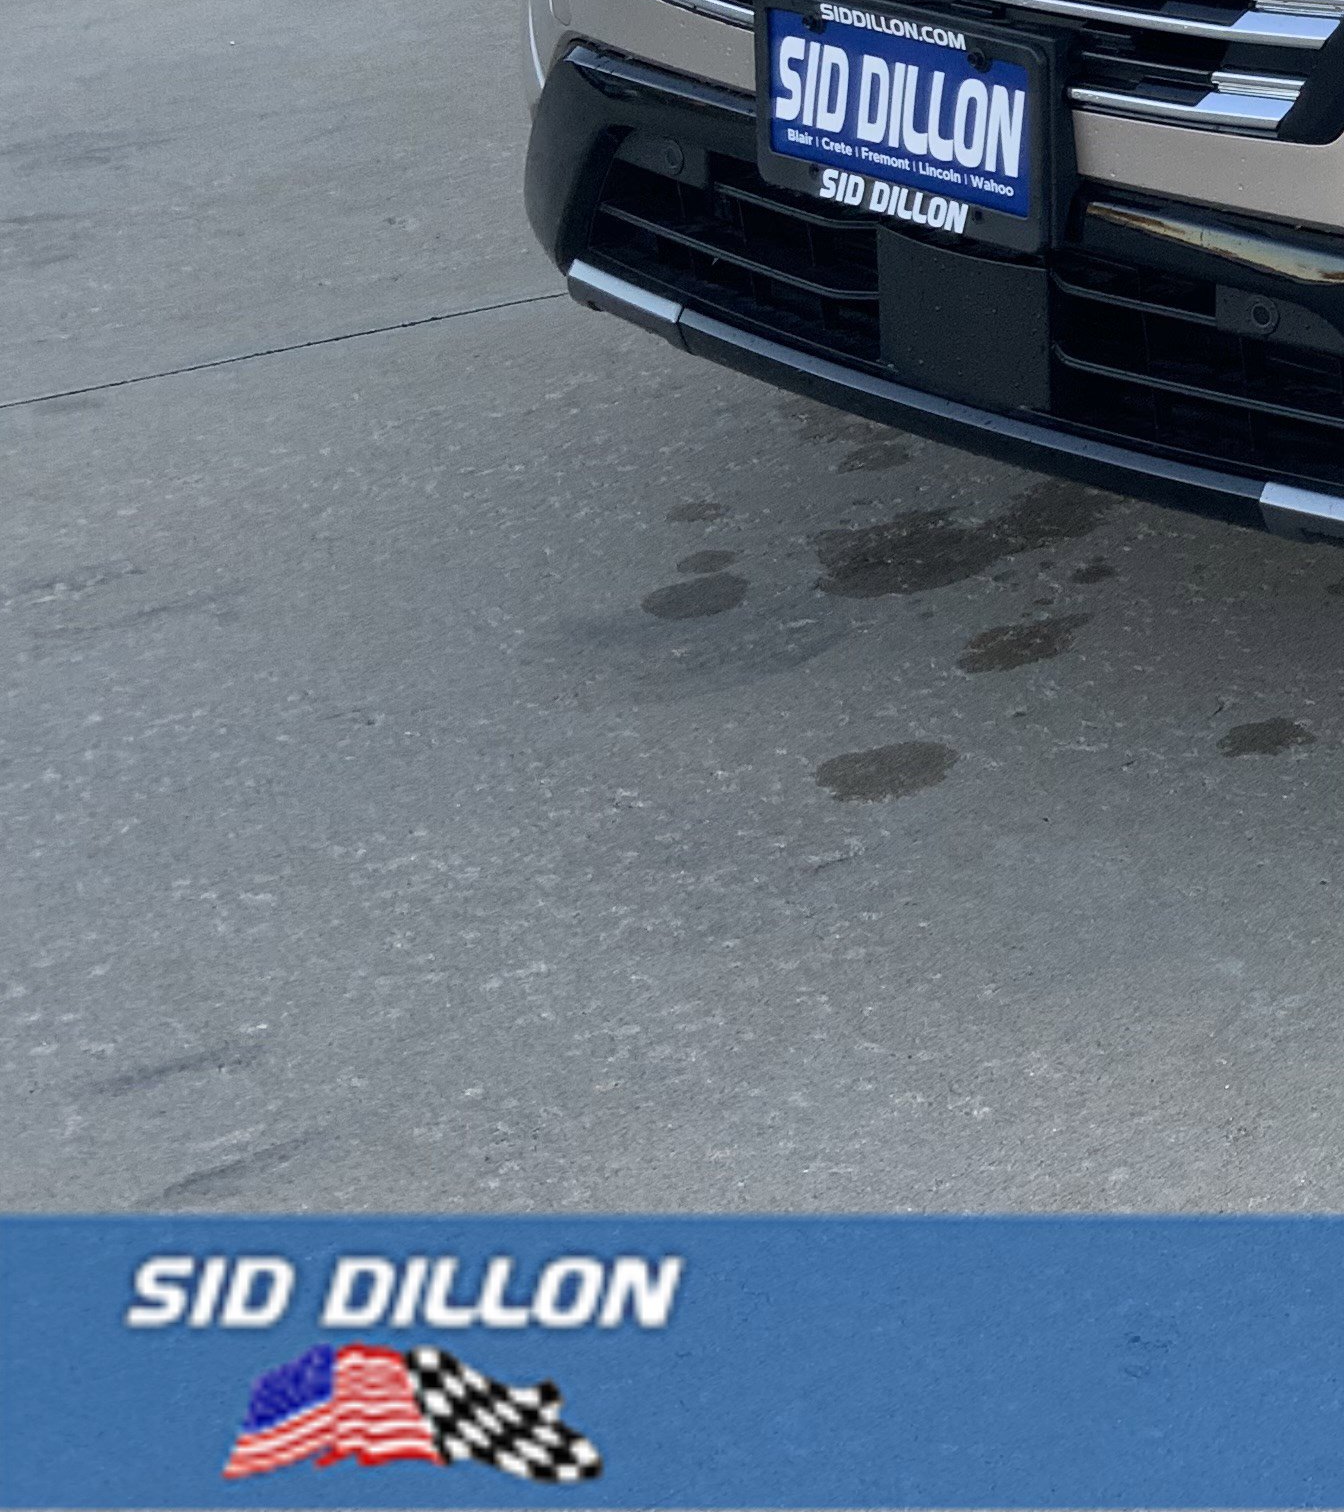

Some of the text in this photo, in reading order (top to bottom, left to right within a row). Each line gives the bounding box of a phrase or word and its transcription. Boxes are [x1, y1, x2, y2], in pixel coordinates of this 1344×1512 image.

[819, 3, 967, 51] SIDDILLON.COM
[775, 35, 1026, 179] SID DILLON
[787, 128, 1015, 198] Blair Crete Fremont Lincoln Wahoo
[819, 168, 969, 235] SID DILLON
